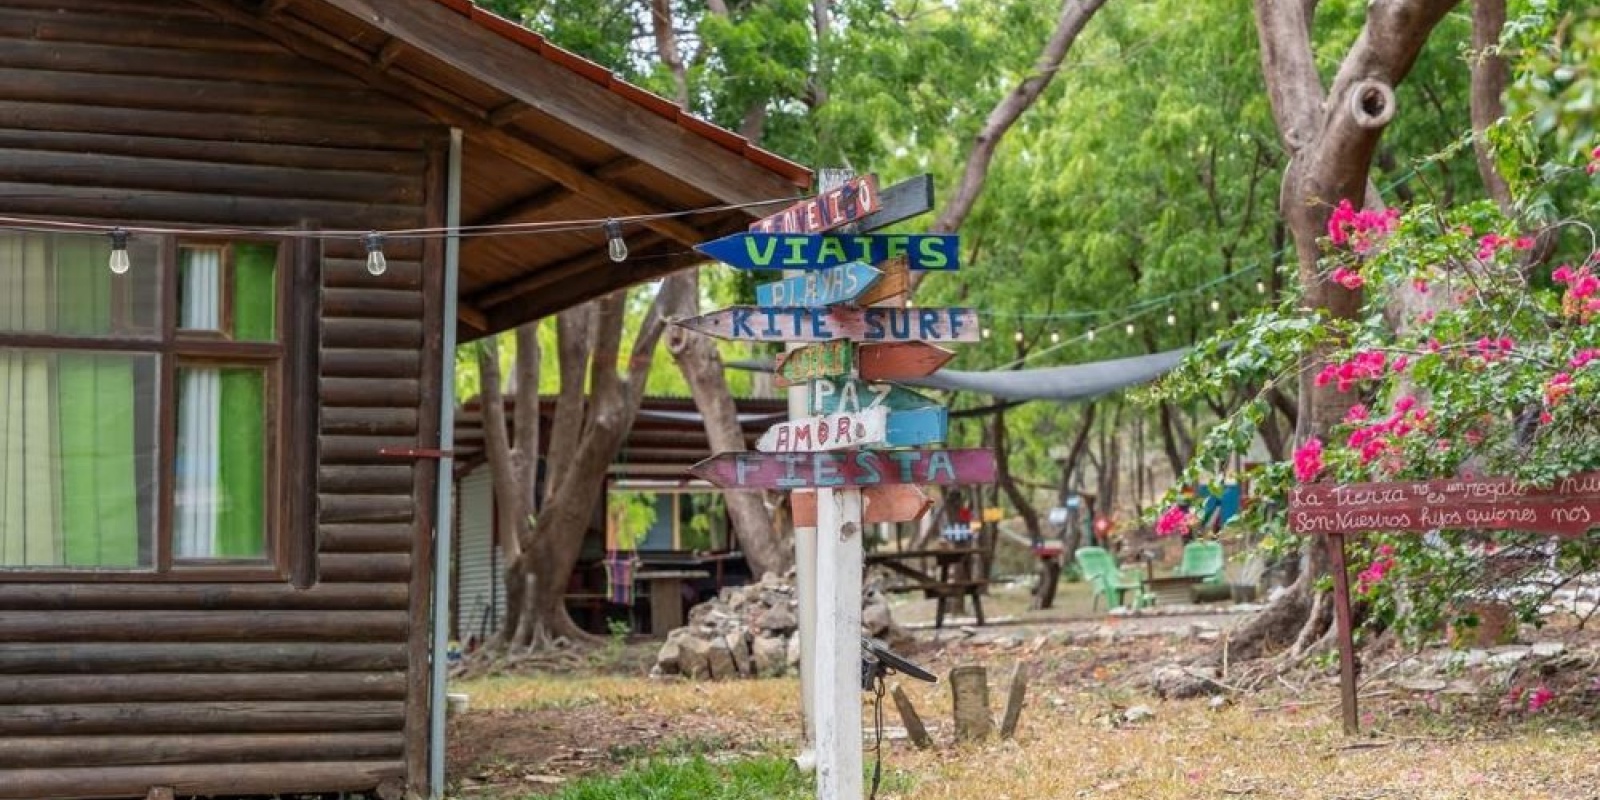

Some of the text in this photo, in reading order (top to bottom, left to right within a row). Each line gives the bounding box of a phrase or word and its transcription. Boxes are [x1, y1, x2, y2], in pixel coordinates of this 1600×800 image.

[744, 236, 948, 268] VIAJES
[732, 308, 966, 339] KITE SURF
[815, 380, 892, 414] PAZ
[735, 451, 956, 486] FIESTA
[1292, 486, 1324, 508] La
[1330, 484, 1409, 507] Tierra
[1412, 483, 1430, 496] no
[1426, 491, 1446, 504] es
[1420, 506, 1462, 528] hijos
[1466, 507, 1537, 527] quienes
[1551, 505, 1592, 525] nos
